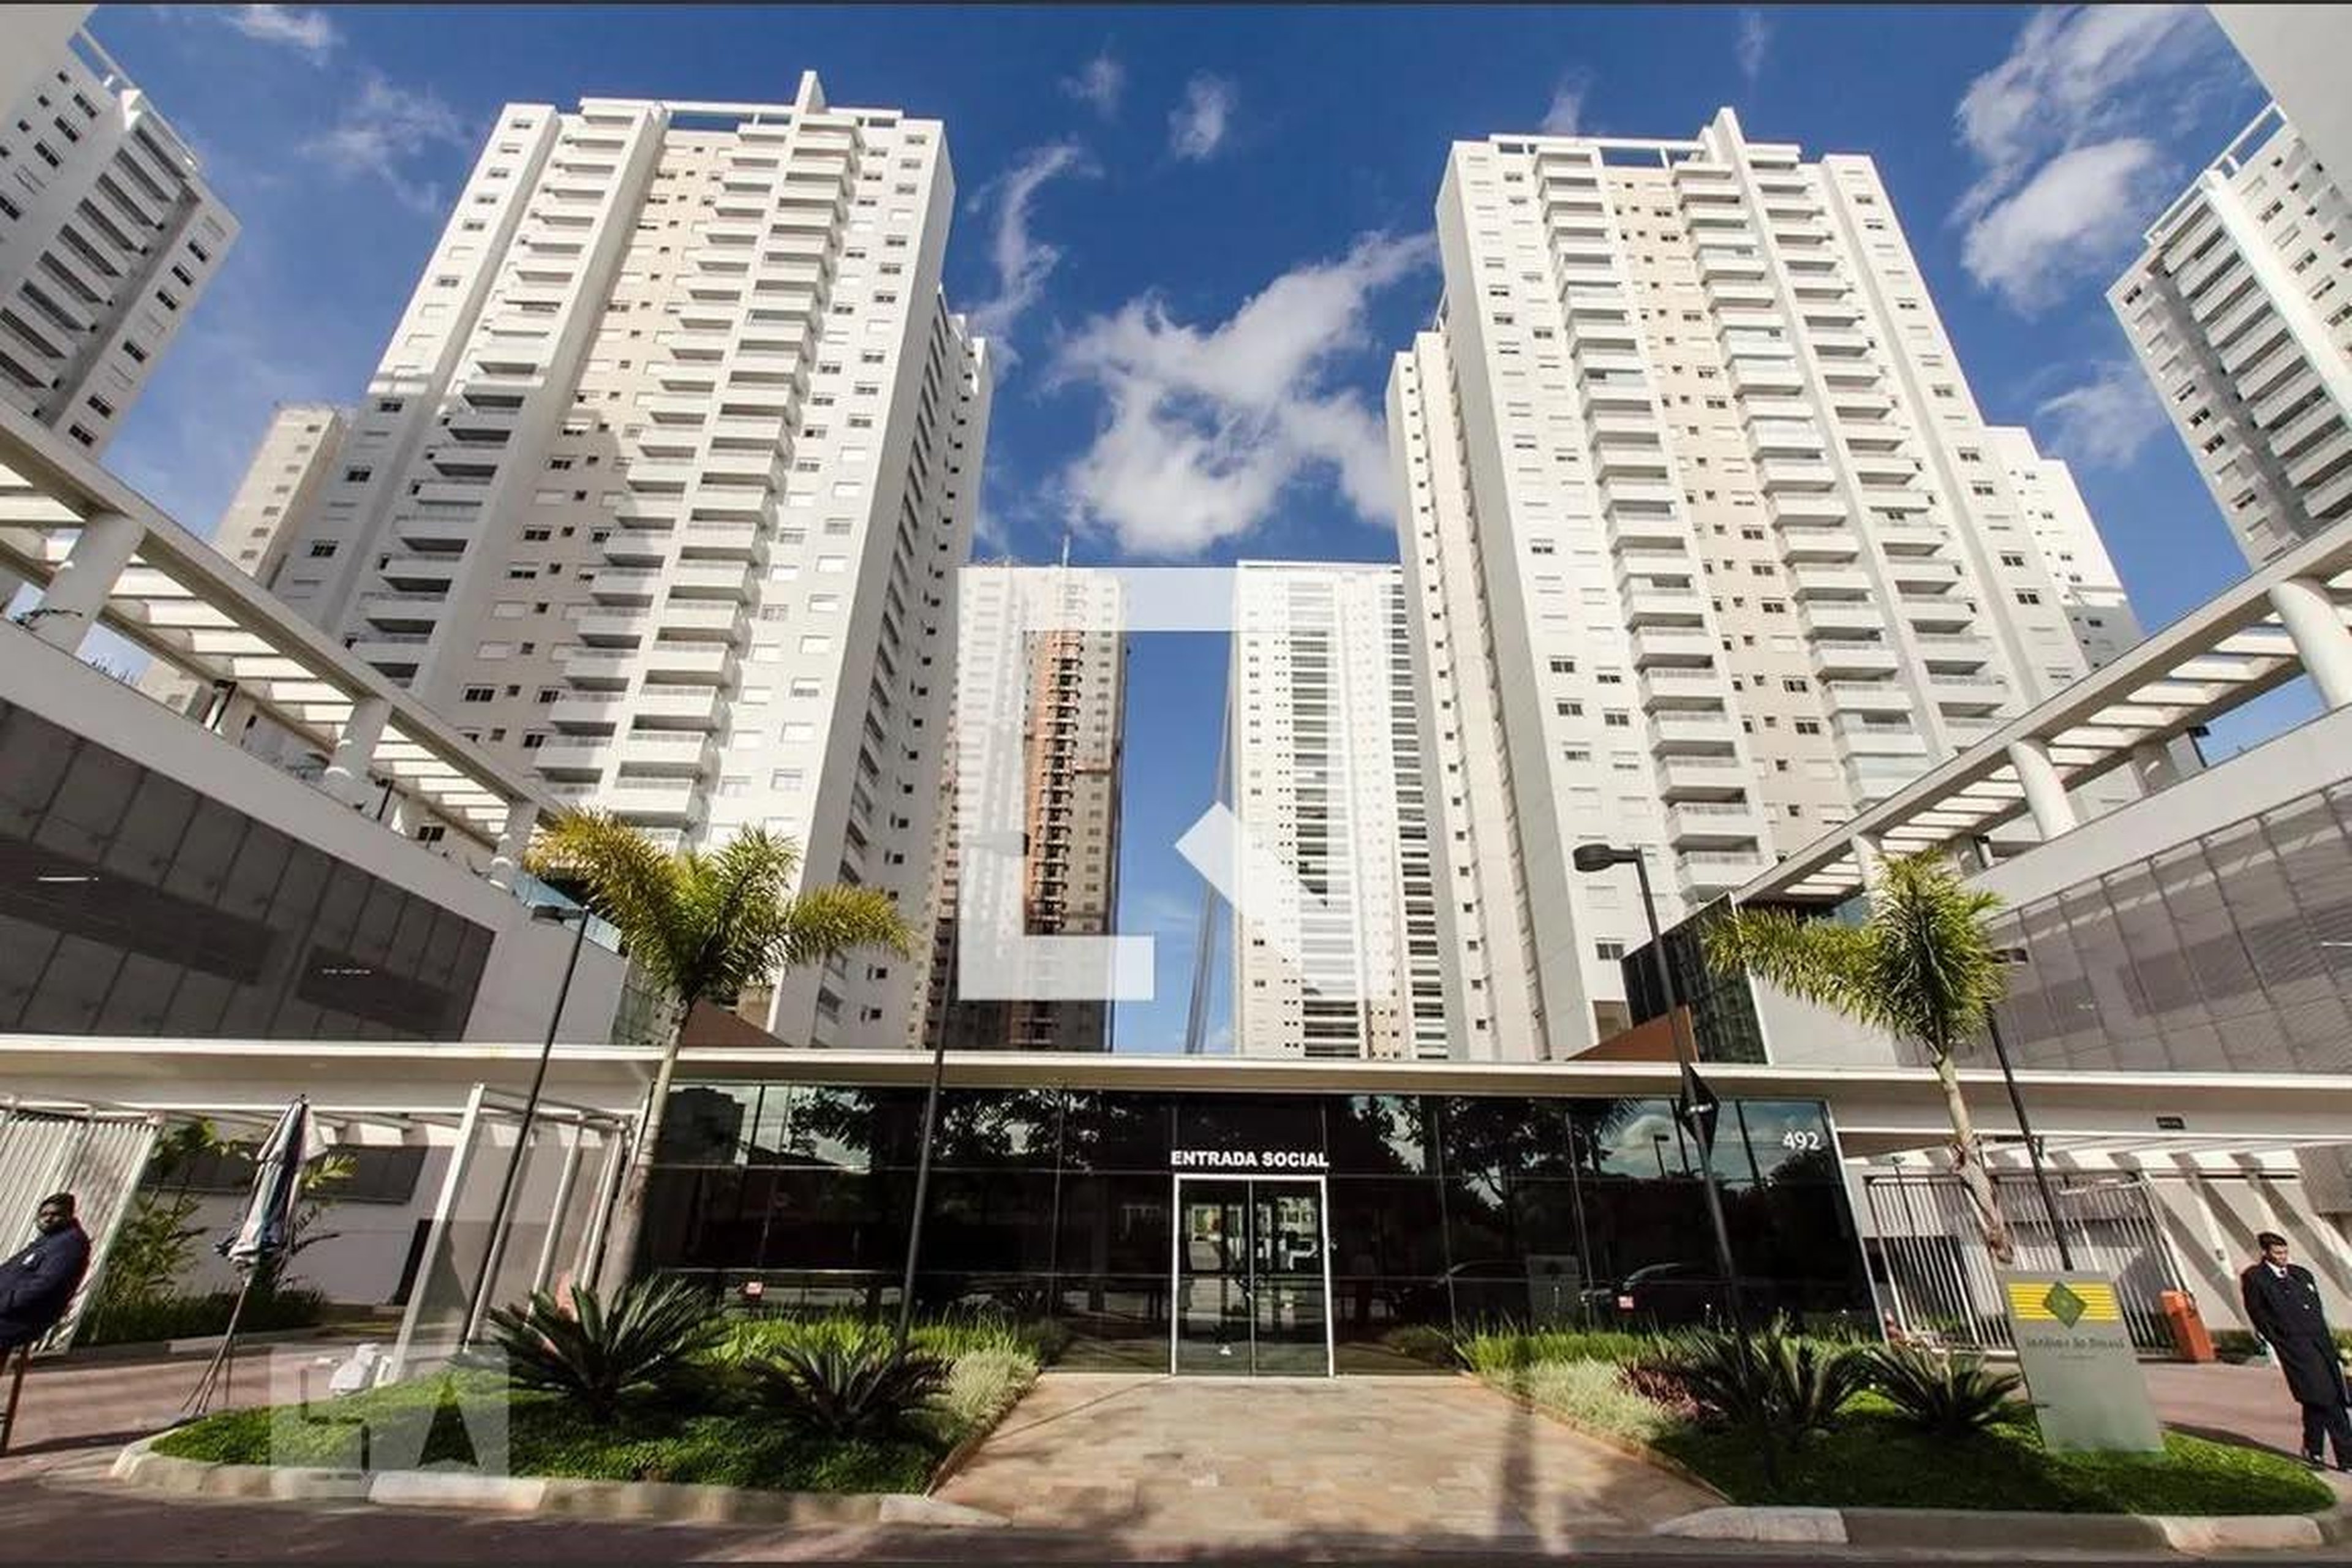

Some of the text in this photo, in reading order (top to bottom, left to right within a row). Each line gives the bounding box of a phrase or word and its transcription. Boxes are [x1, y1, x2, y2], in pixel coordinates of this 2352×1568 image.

[1782, 1131, 1821, 1150] 492
[1171, 1151, 1329, 1167] ENTRADA SOCIAL
